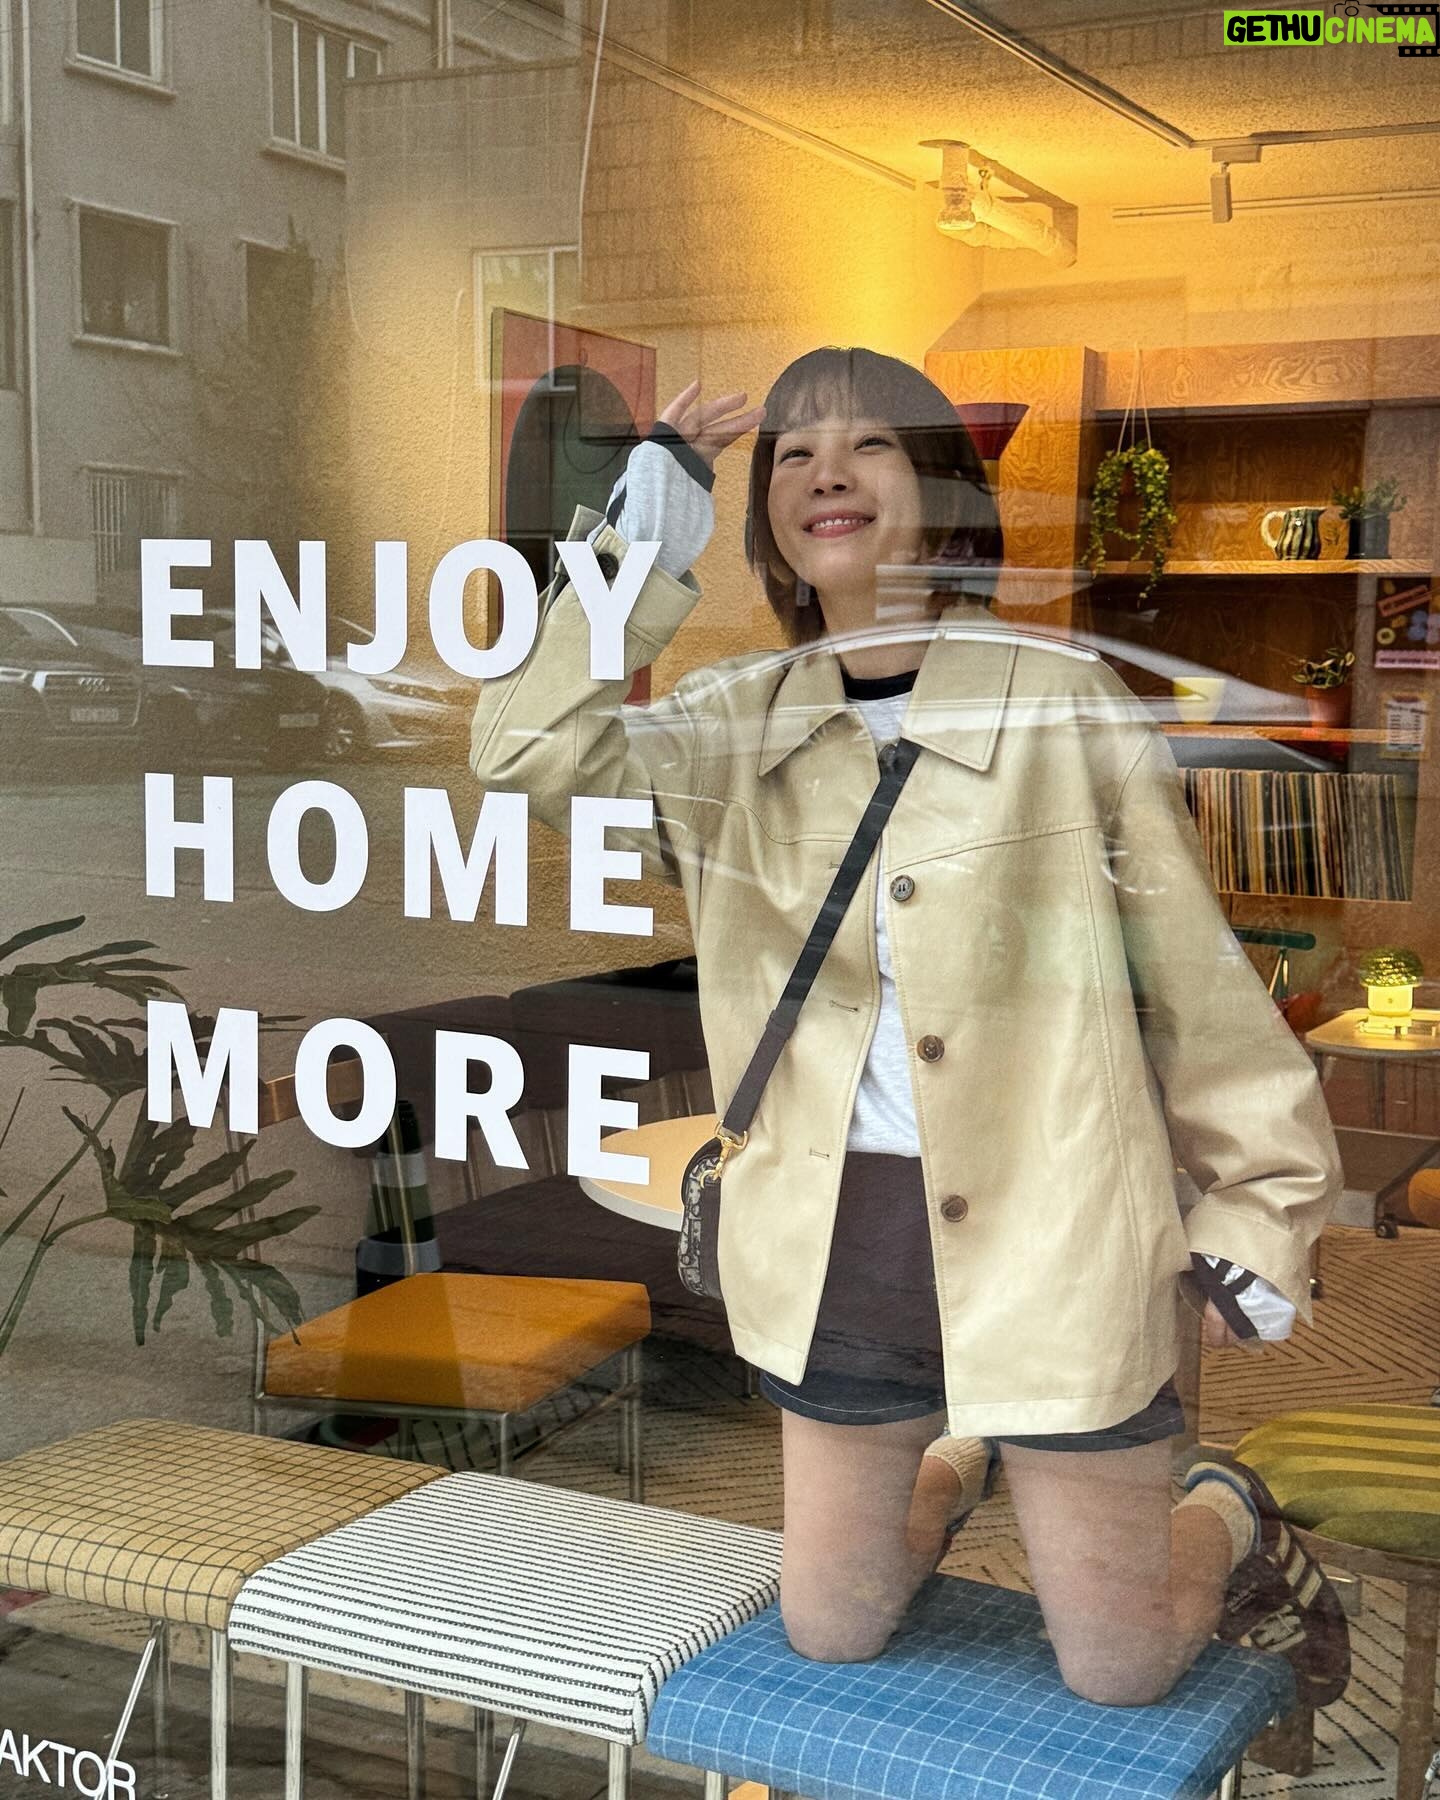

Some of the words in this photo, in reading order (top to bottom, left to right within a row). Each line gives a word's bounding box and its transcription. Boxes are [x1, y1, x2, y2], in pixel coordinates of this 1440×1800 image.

[140, 538, 663, 682] ENJOY
[144, 772, 655, 937] HOME
[146, 1000, 651, 1186] MORE
[0, 1728, 137, 1800] AKTOR
